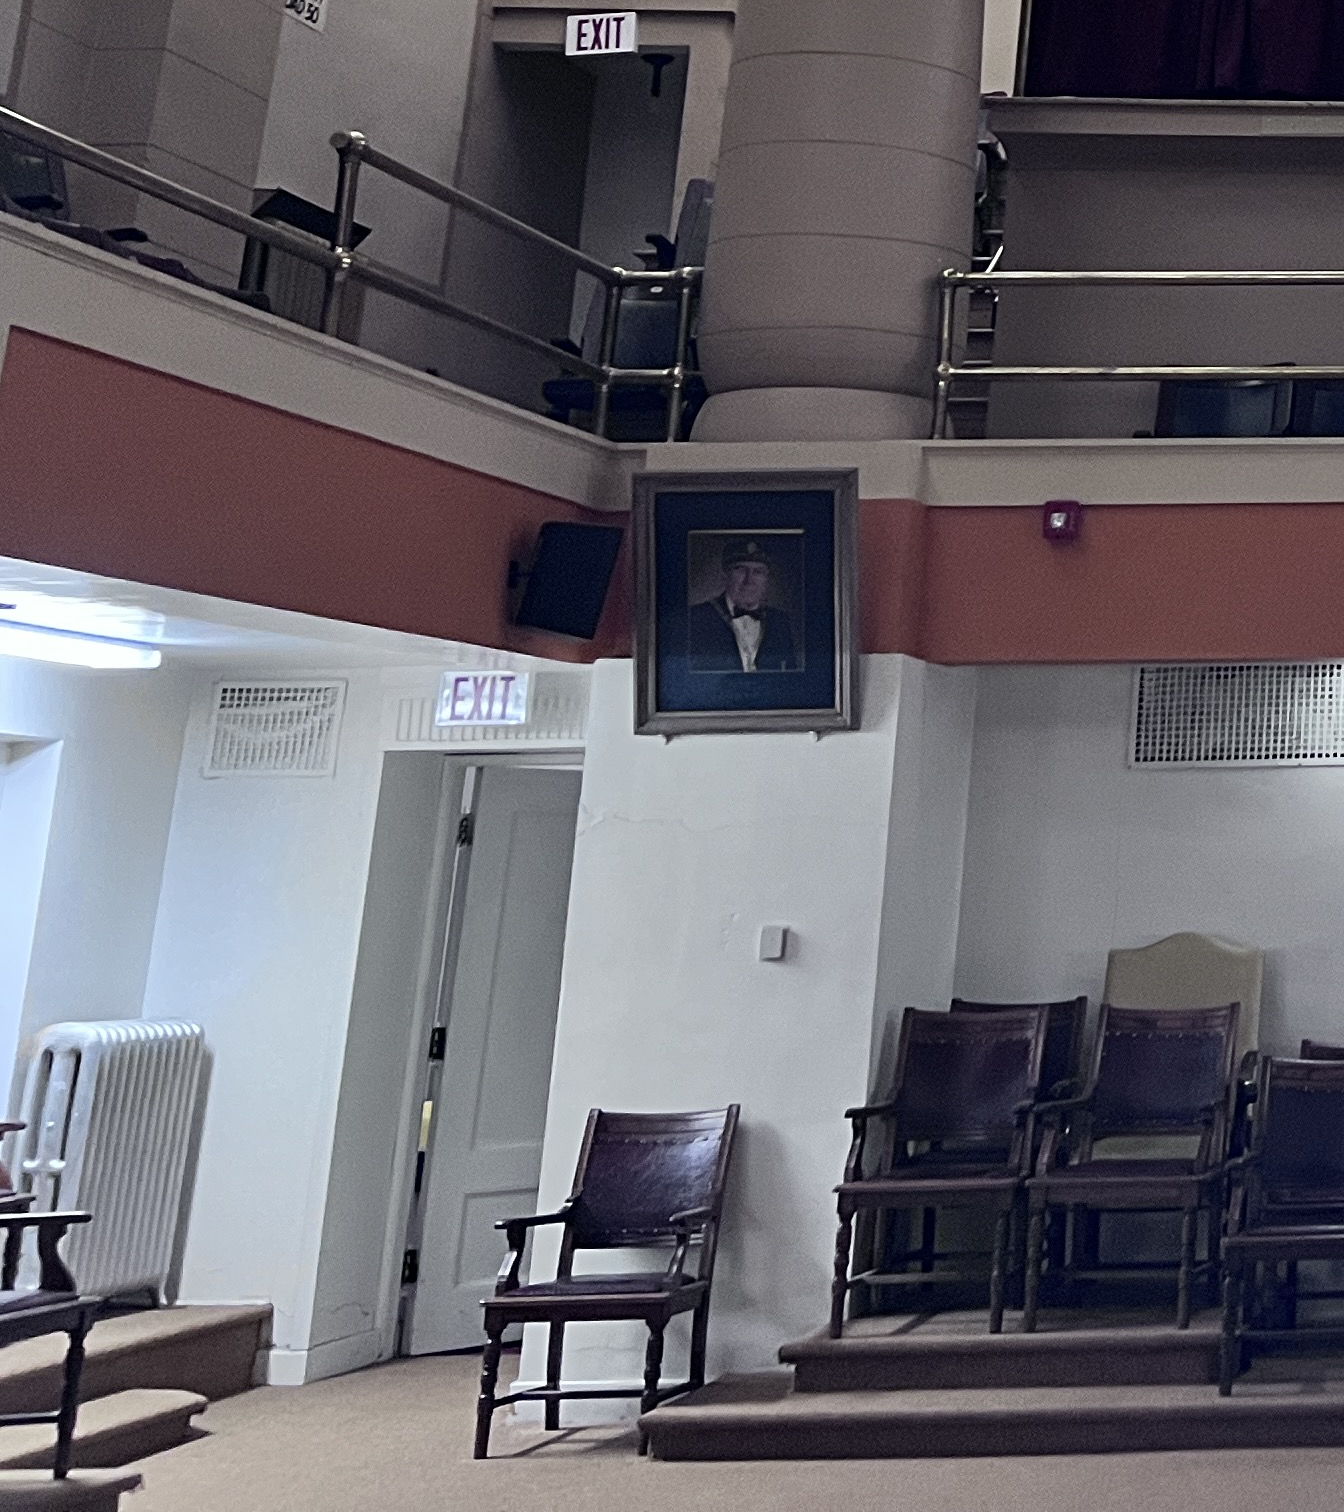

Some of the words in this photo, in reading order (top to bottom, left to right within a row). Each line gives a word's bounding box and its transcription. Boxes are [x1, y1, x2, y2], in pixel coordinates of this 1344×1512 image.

[305, 3, 319, 23] 50
[576, 16, 625, 51] EXIT
[449, 676, 515, 720] EXIT
